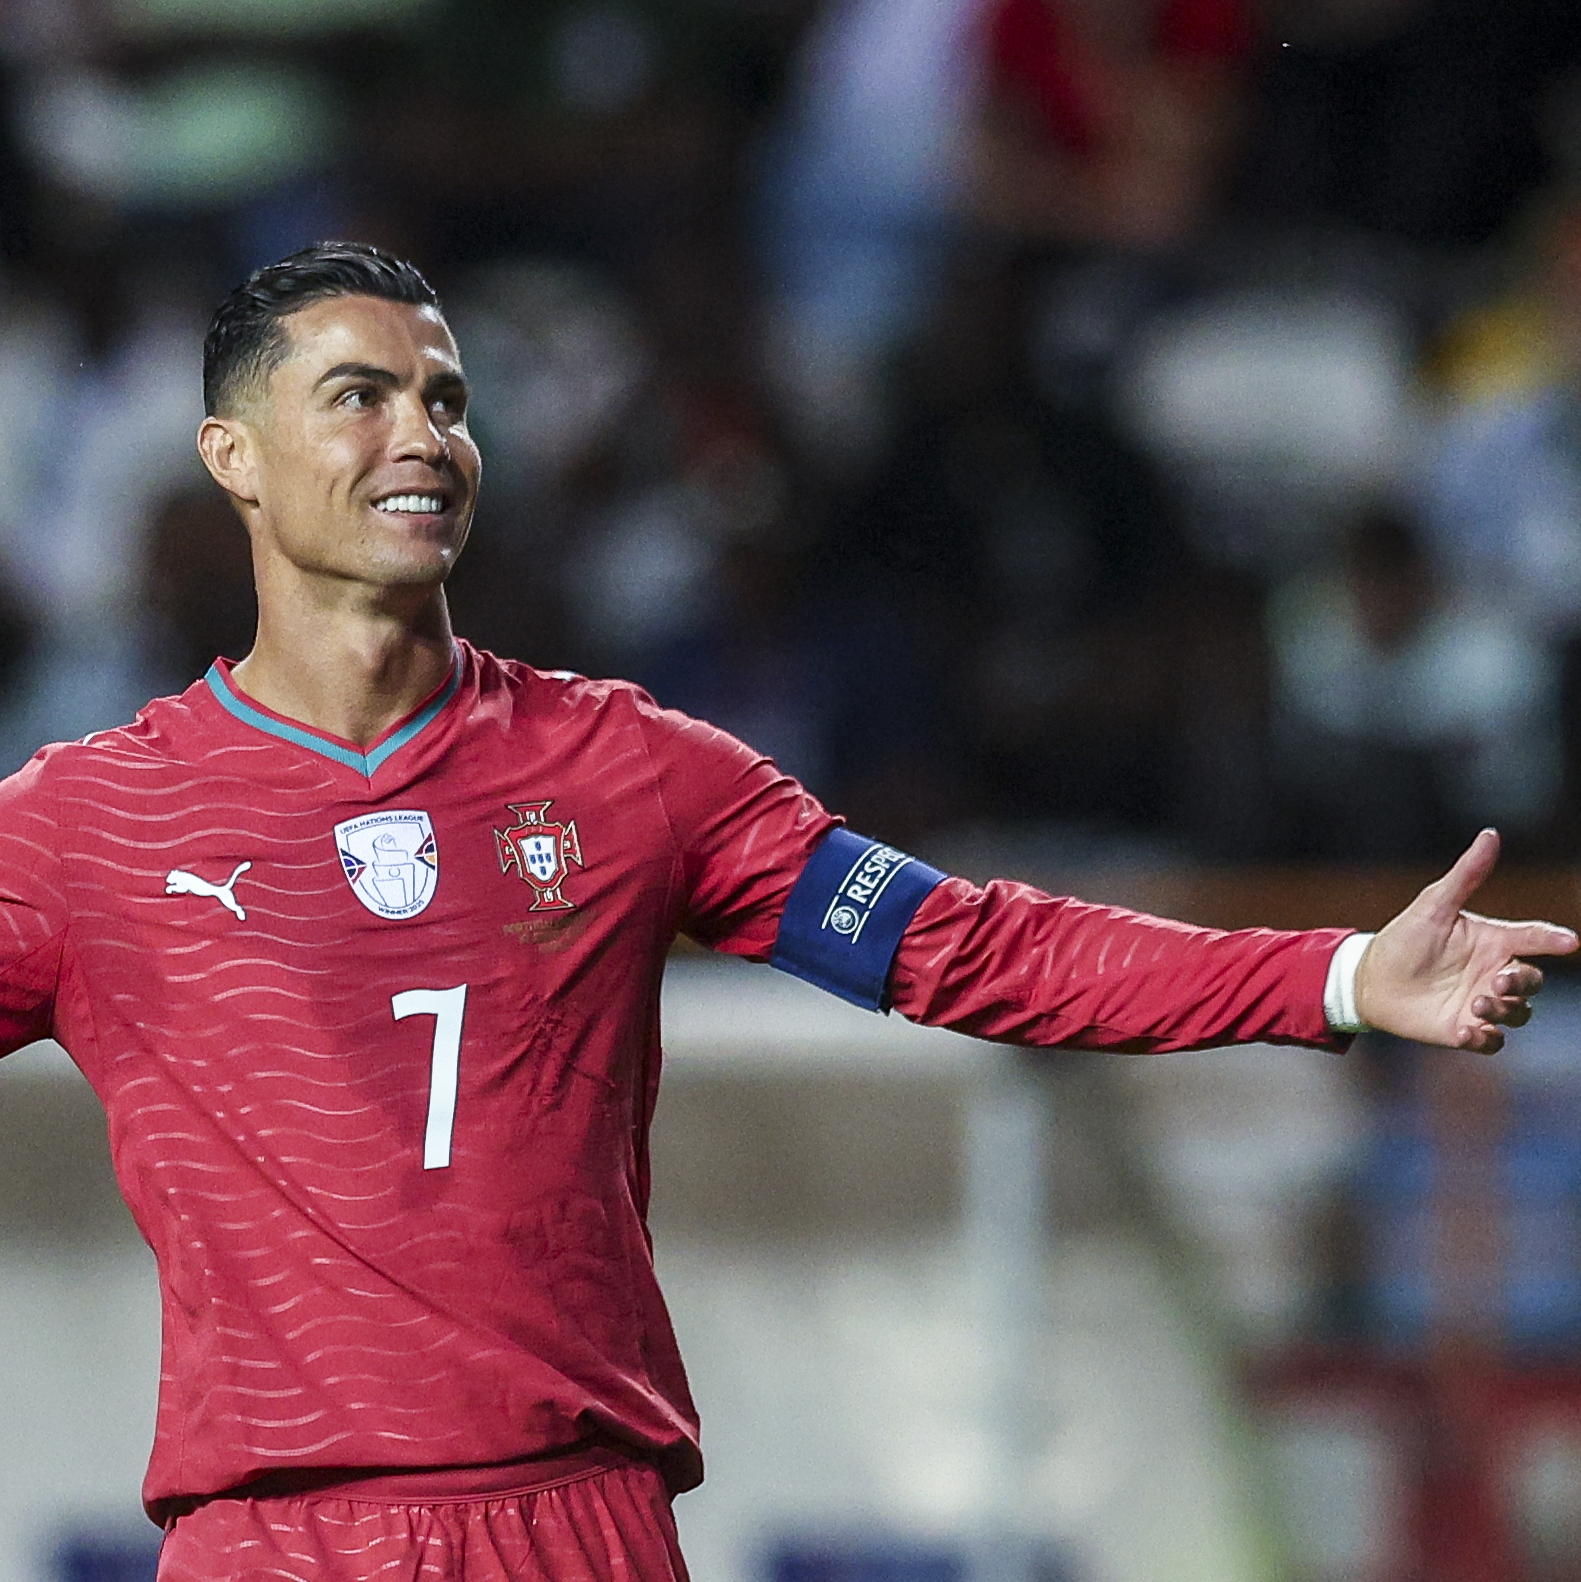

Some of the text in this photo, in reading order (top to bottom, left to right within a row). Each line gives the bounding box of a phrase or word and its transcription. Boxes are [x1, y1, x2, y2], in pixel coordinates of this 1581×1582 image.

[359, 815, 393, 827] NATIONS
[394, 814, 424, 822] LEAGUE
[391, 983, 468, 1171] 7
